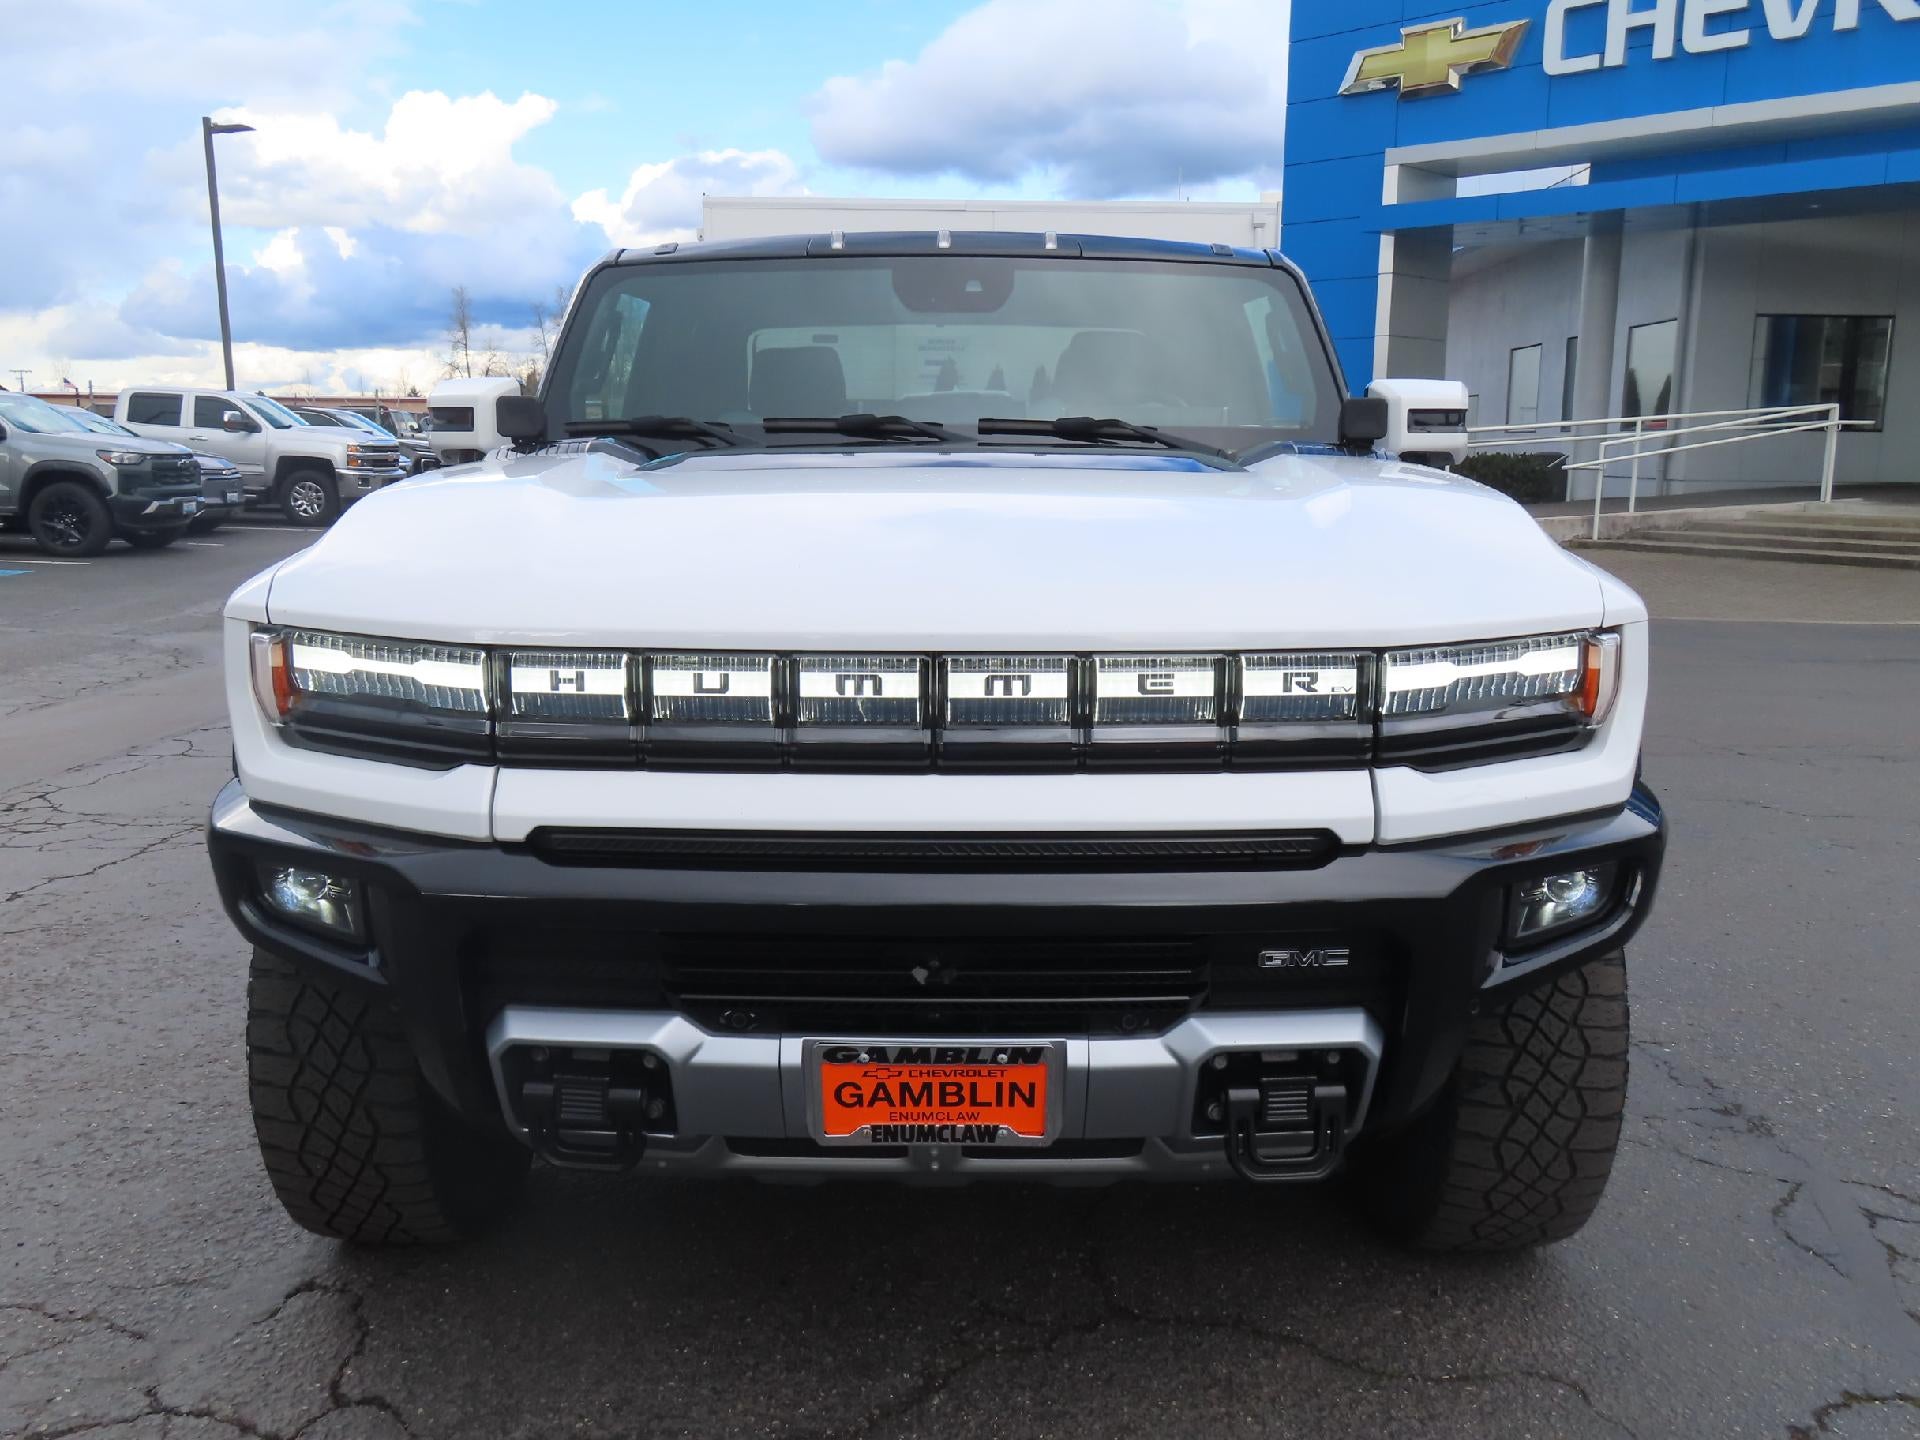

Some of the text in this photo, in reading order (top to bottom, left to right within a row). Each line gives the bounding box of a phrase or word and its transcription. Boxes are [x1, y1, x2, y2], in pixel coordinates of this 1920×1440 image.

[1258, 949, 1350, 968] GMC
[822, 1046, 1045, 1064] GAMBLIN
[908, 1069, 1008, 1078] CHEVROLET
[833, 1081, 1036, 1108] GAMBLIN
[889, 1111, 980, 1122] ENUMCLAW
[871, 1124, 1000, 1143] ENUMCLAW
